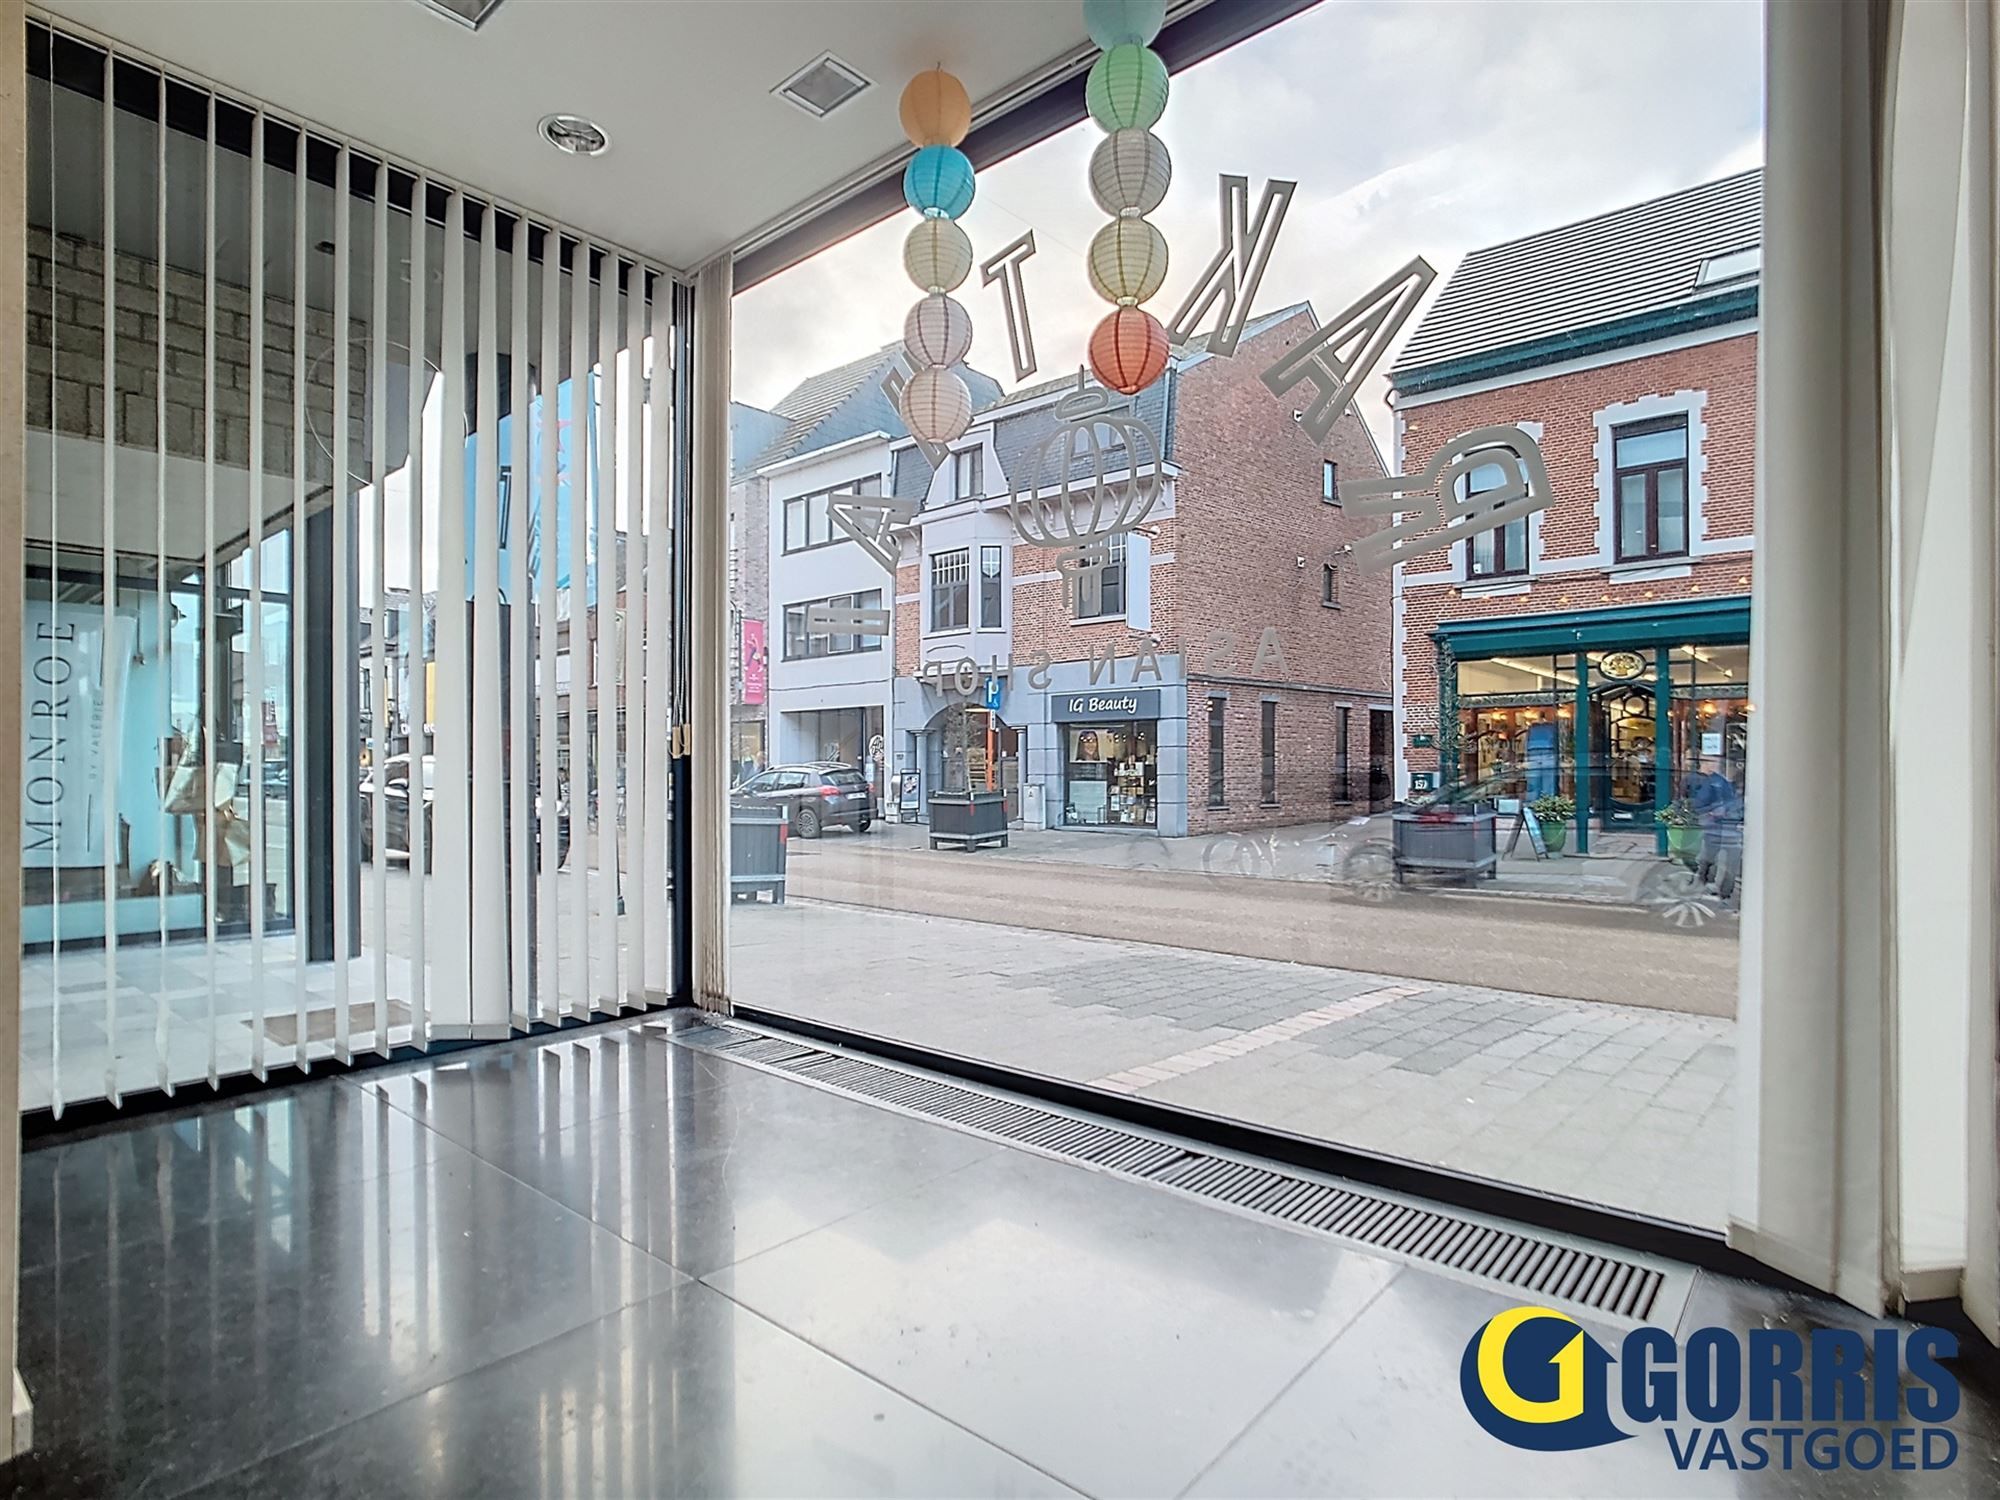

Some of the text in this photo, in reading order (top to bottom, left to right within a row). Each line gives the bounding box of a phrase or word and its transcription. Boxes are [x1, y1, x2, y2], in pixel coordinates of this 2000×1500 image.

[23, 622, 75, 853] MONROE
[1068, 696, 1137, 714] IG Beauty
